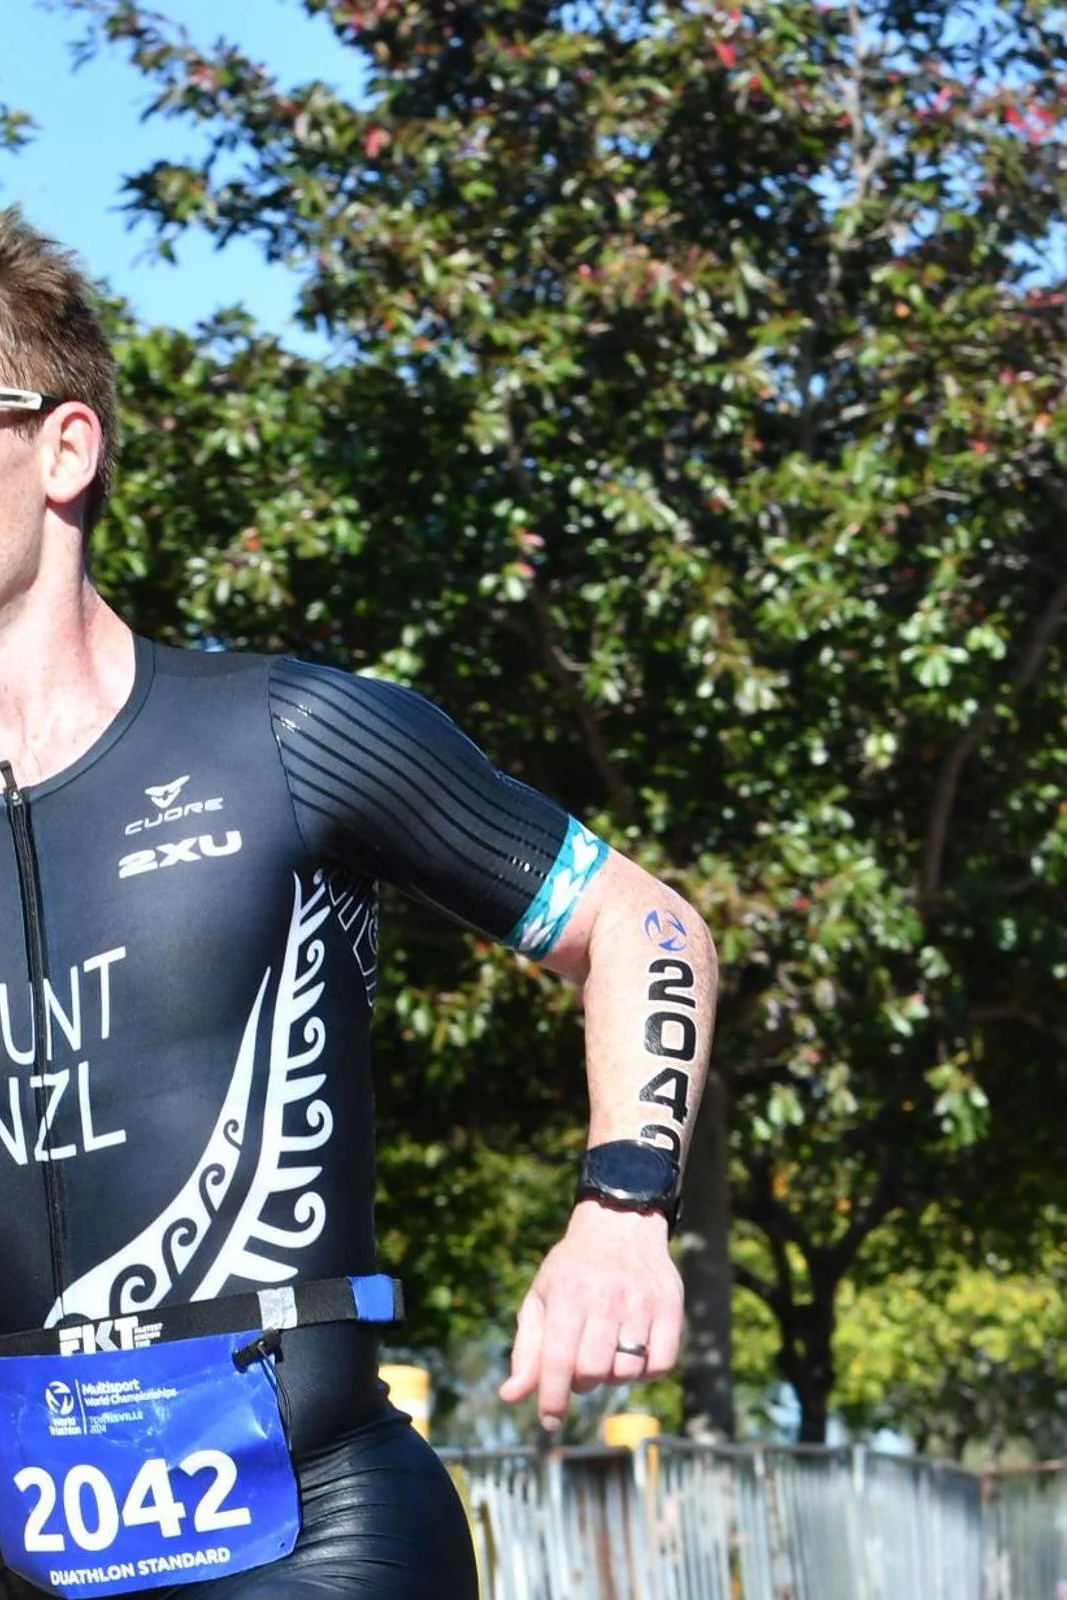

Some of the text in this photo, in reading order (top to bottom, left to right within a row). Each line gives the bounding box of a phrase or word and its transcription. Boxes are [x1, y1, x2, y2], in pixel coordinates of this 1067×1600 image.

[124, 796, 224, 836] CUORE
[118, 830, 242, 879] 2XU
[81, 1378, 141, 1396] Multisport
[83, 1386, 179, 1407] World Championships
[13, 1449, 252, 1552] 2042
[49, 1546, 232, 1587] DUATHLON STANDARD
